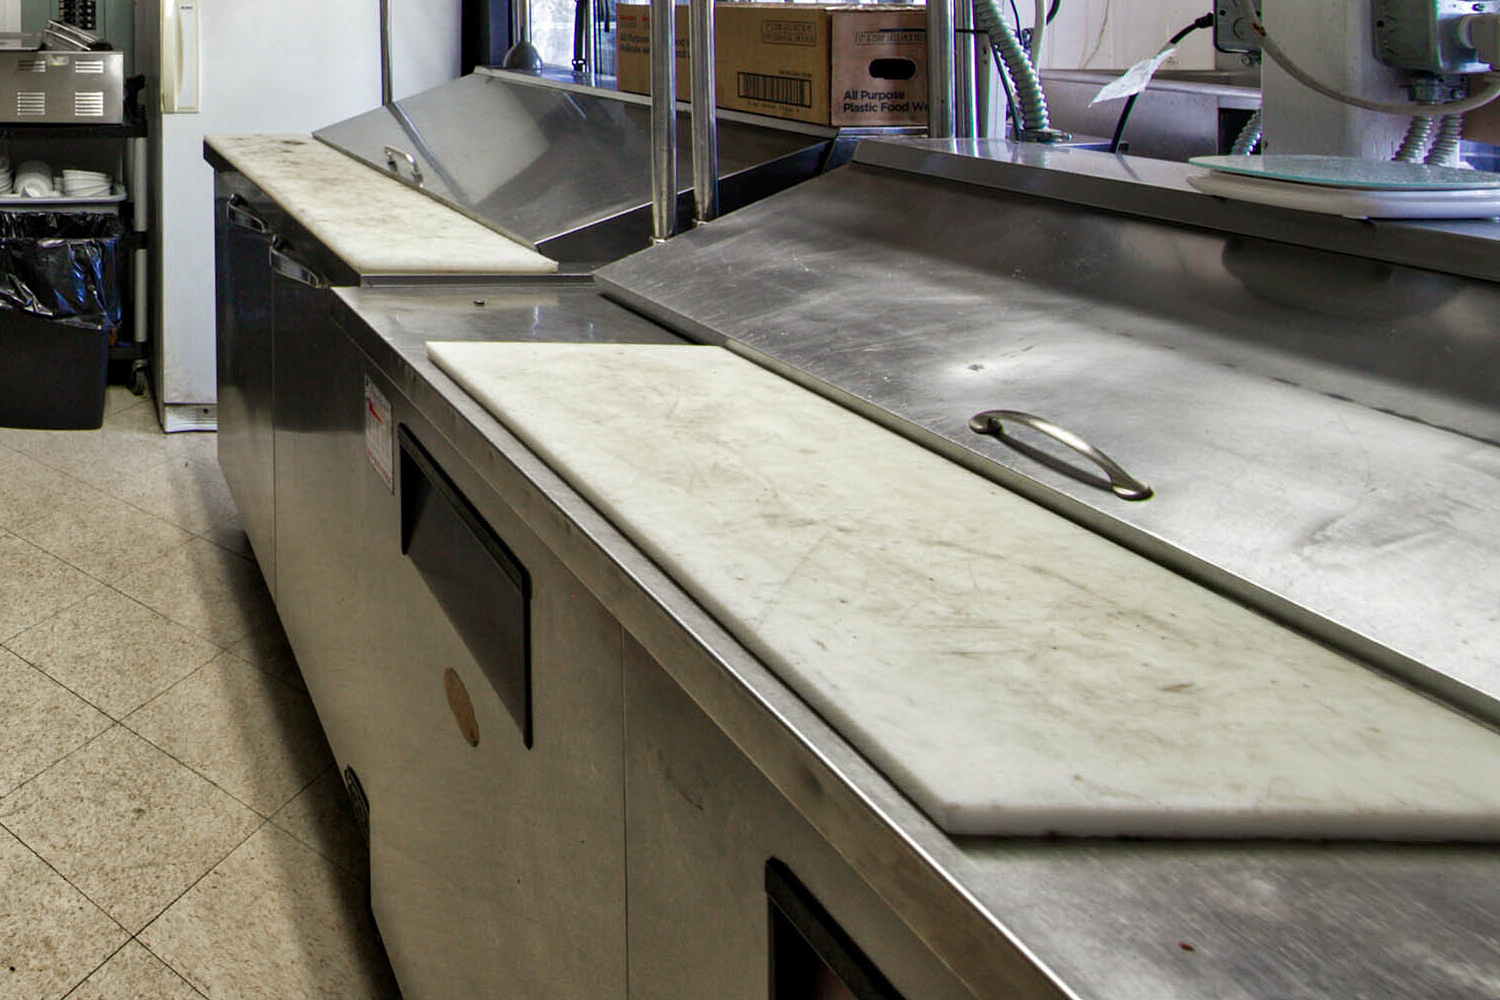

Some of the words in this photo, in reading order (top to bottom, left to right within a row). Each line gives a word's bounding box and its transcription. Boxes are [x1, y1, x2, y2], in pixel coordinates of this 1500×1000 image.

[844, 91, 858, 100] All
[861, 91, 905, 102] Purpose
[843, 103, 877, 113] Plastic
[881, 103, 909, 113] Food
